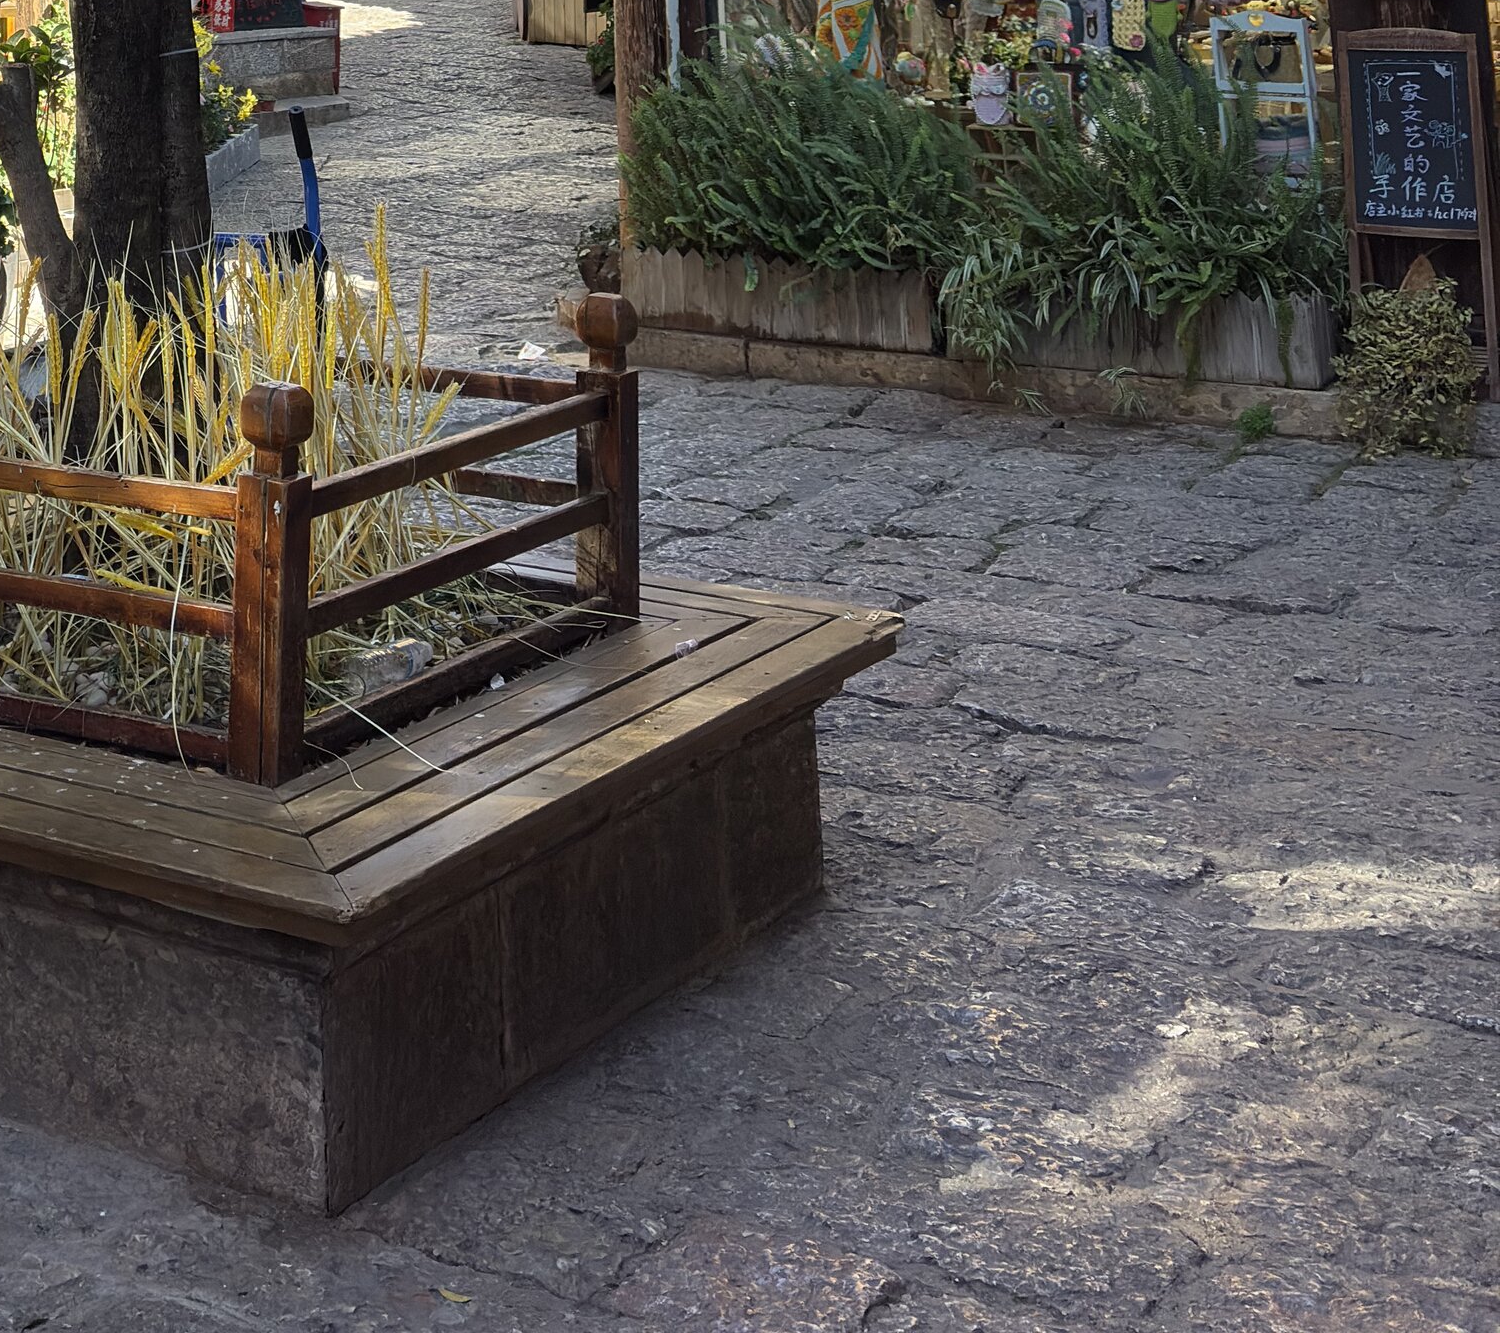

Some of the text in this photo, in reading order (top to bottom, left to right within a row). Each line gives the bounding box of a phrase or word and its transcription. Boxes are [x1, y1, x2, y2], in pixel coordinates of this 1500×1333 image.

[1396, 71, 1430, 174] 一家文艺的
[1369, 174, 1456, 204] 手作店
